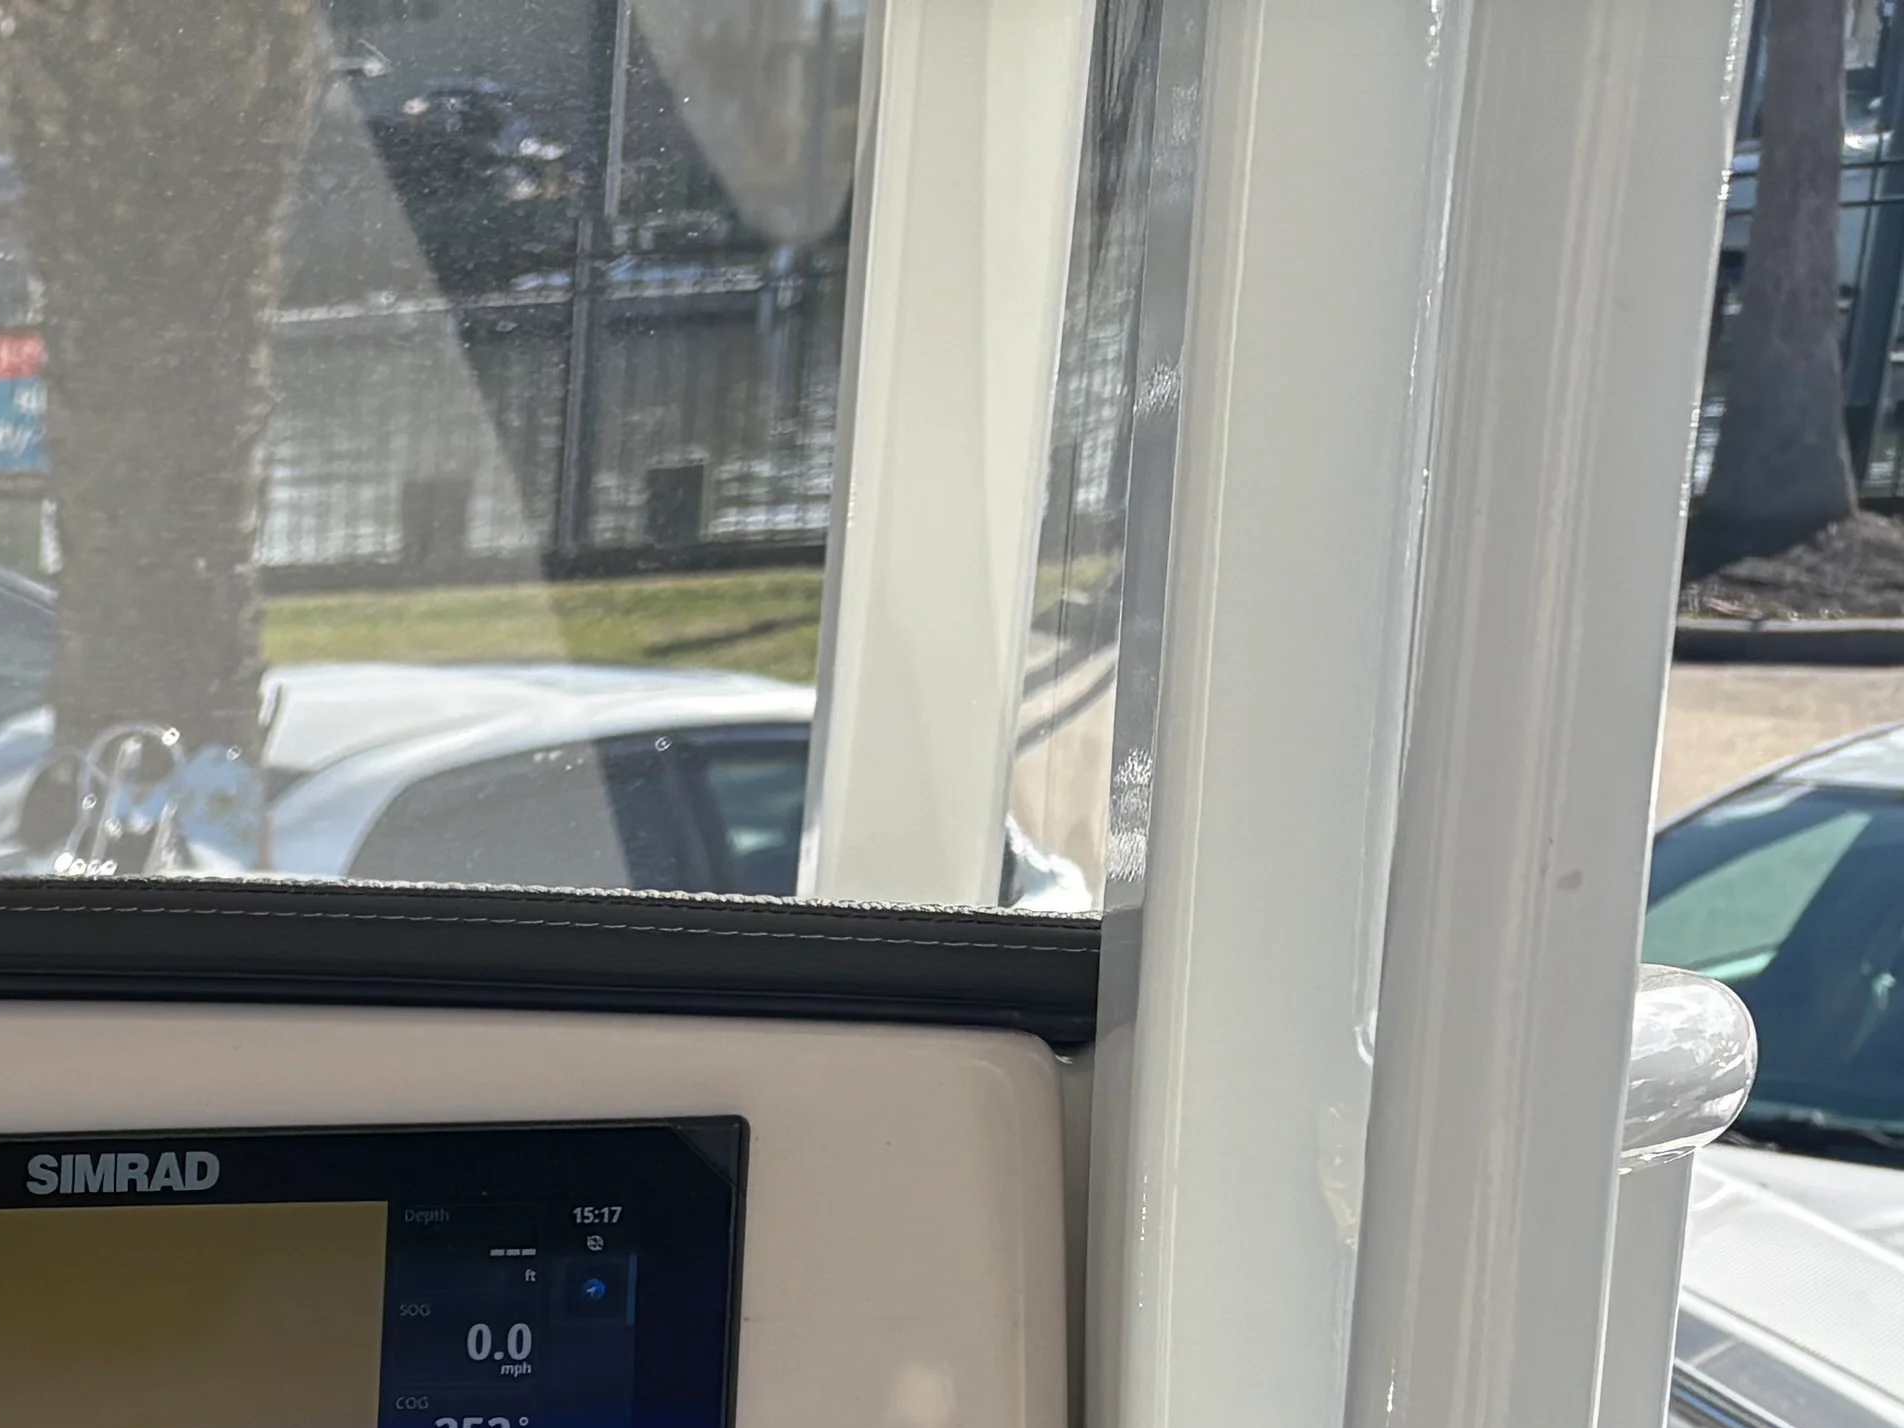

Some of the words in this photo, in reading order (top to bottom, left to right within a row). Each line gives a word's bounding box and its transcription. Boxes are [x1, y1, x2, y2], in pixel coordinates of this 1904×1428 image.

[26, 1151, 221, 1195] SIMRAD
[404, 1208, 450, 1226] Depth
[573, 1206, 622, 1224] 15:17
[524, 1268, 537, 1282] ft
[399, 1303, 431, 1317] SOG
[466, 1323, 533, 1361] 0.0
[500, 1362, 533, 1377] mph
[395, 1396, 429, 1410] COG
